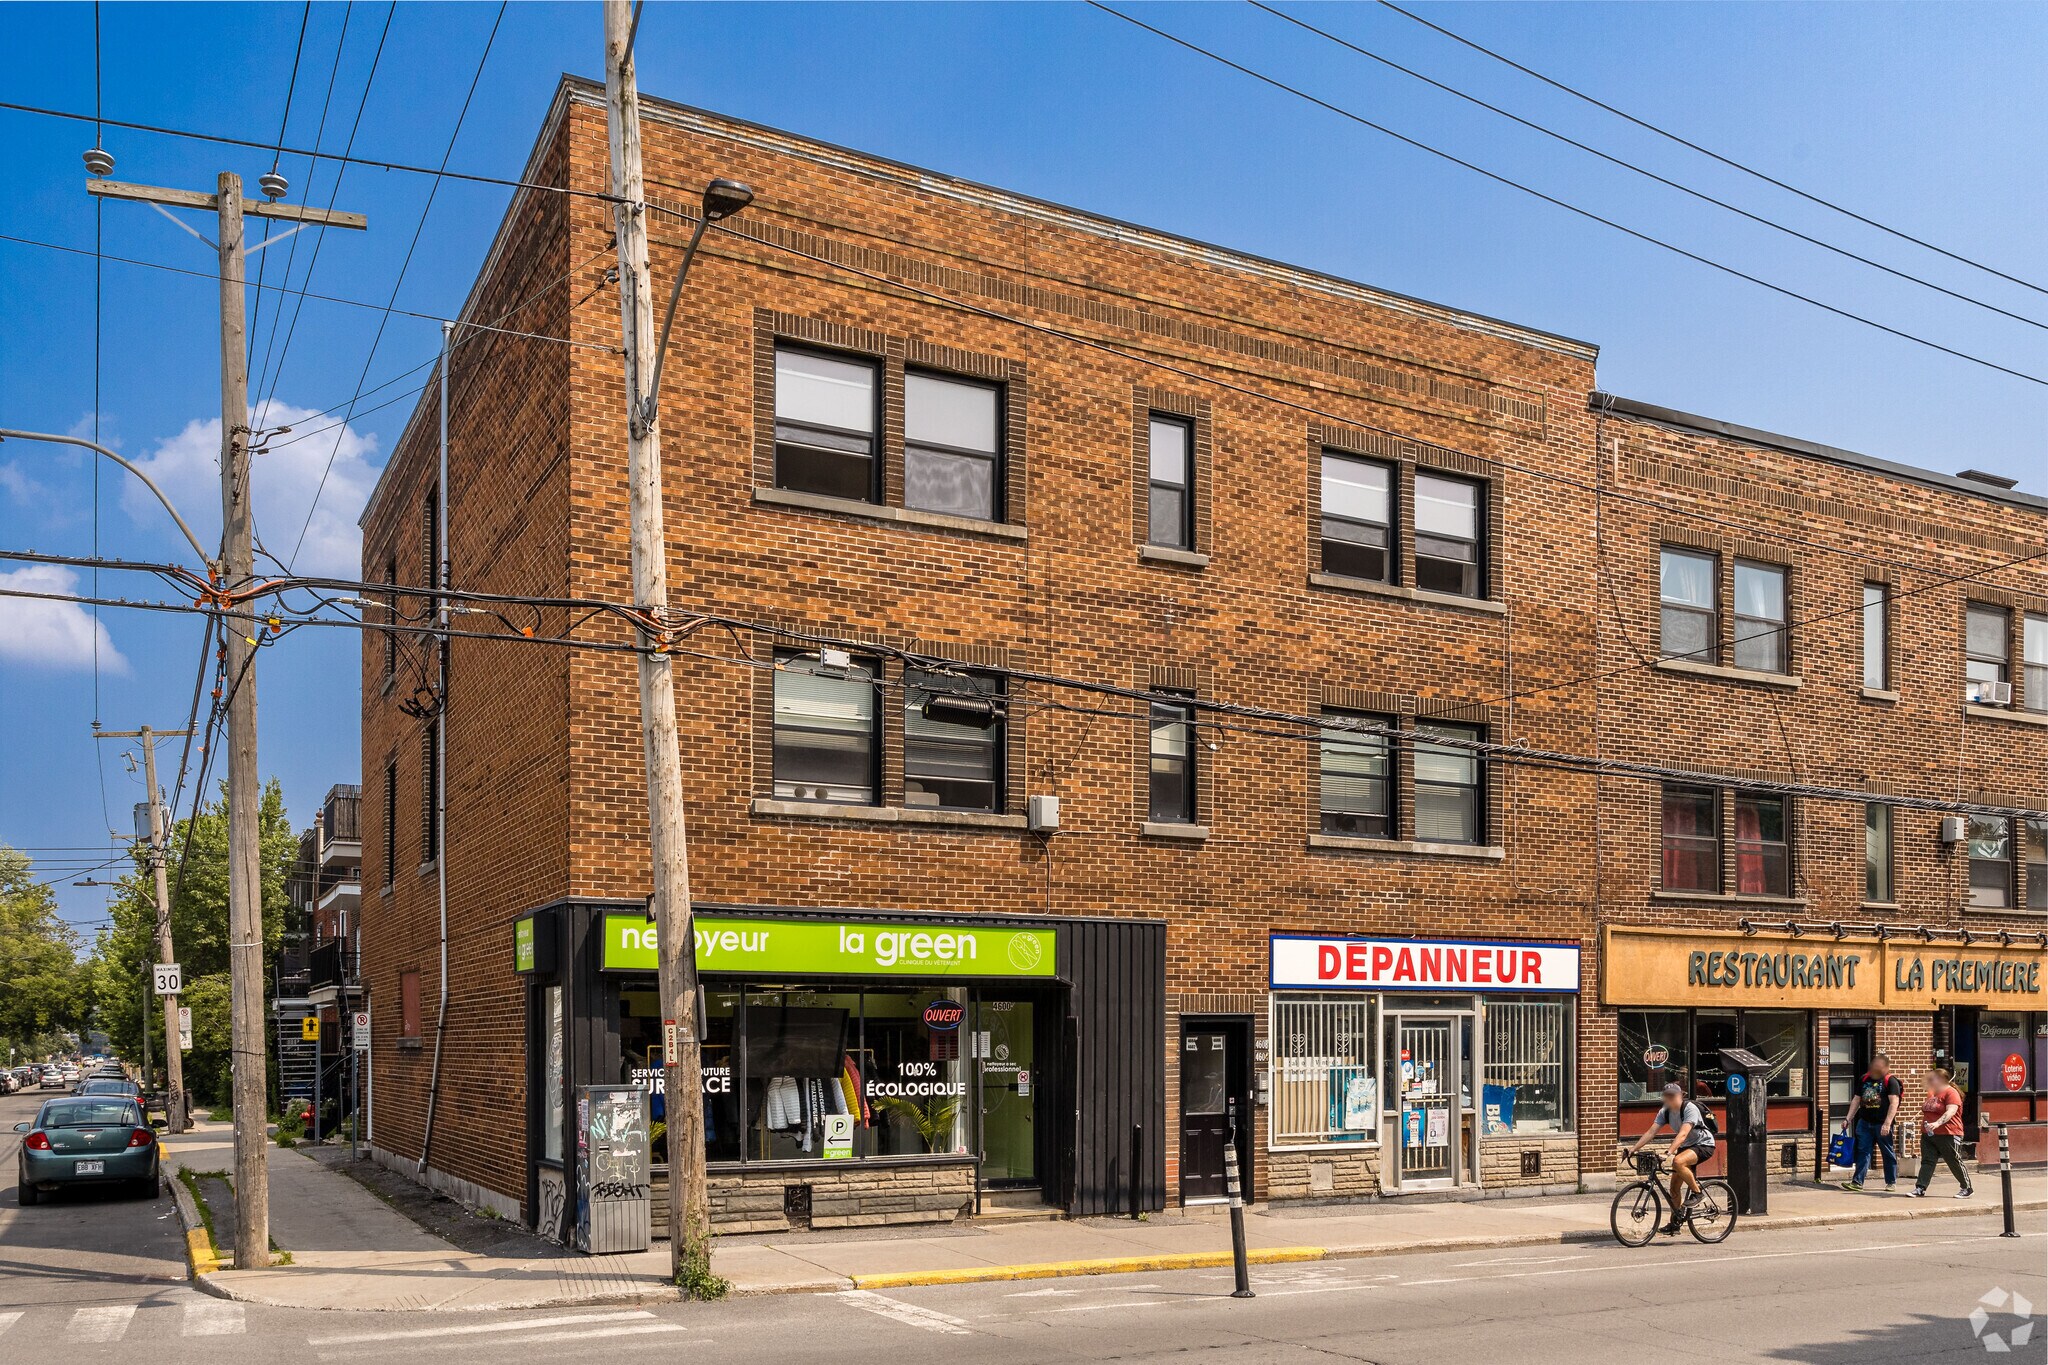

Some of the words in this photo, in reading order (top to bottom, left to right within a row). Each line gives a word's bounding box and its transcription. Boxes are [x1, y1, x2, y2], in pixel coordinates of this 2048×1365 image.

[621, 927, 769, 957] neyeur
[839, 926, 864, 953] la
[875, 931, 977, 966] green
[1318, 942, 1542, 984] DÉPANNEUR
[1689, 950, 1861, 987] RESTAURANT
[1895, 957, 1925, 991] LA
[1932, 959, 2041, 992] PREMIERE
[157, 974, 178, 990] 30
[925, 1009, 962, 1022] OUVERT
[1645, 1051, 1667, 1062] OUVERT
[631, 1068, 665, 1078] SERVIC
[700, 1067, 730, 1076] UTURE
[897, 1062, 937, 1076] 100%
[2004, 1064, 2023, 1073] Loterie
[2006, 1073, 2021, 1082] vidéo
[866, 1080, 966, 1096] ÉCOLOGIQUE
[836, 1121, 844, 1132] P
[830, 1150, 850, 1158] green
